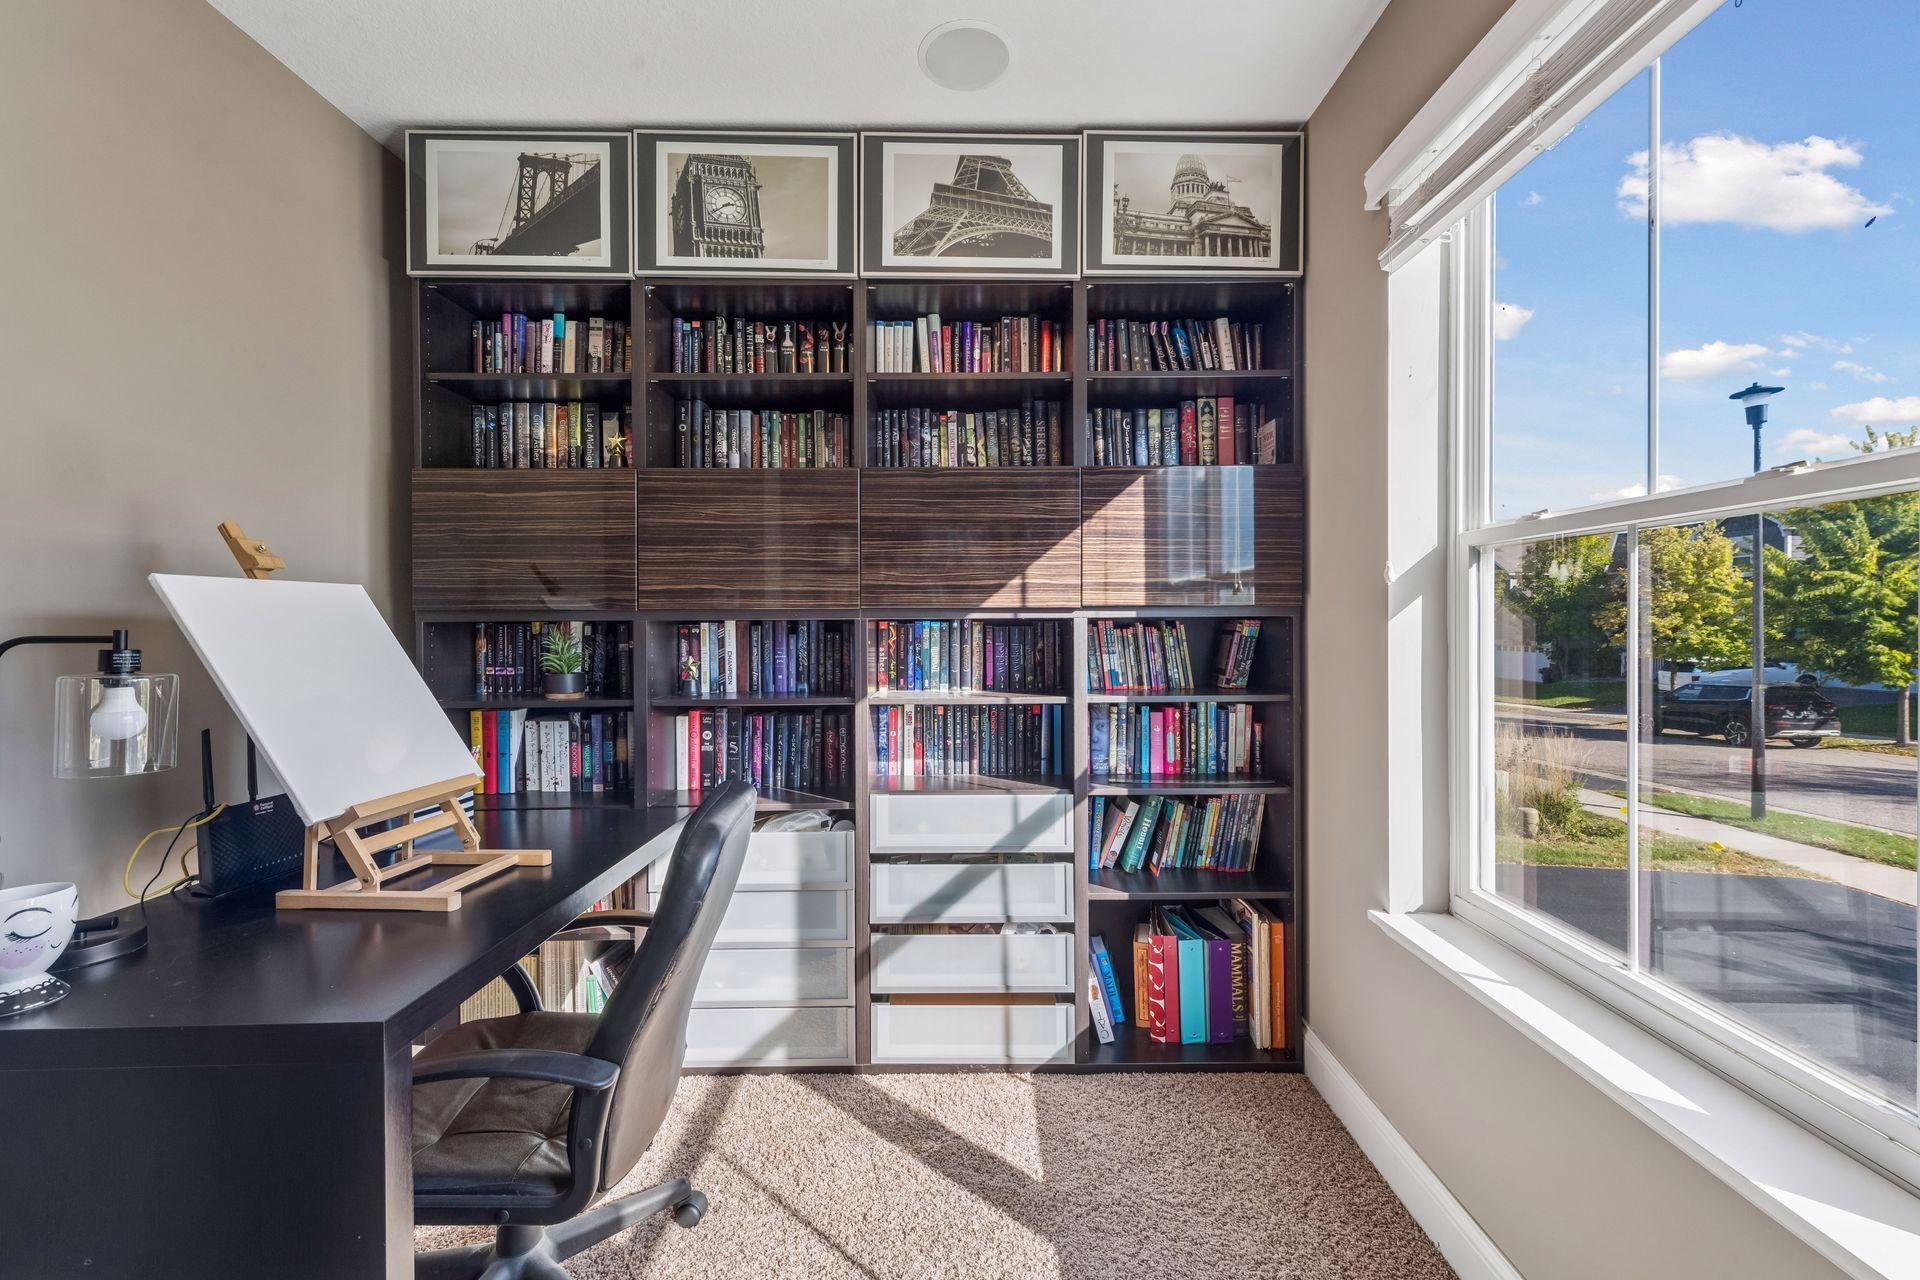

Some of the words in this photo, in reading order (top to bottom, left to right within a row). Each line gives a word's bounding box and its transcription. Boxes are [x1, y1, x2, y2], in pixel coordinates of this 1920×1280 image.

[746, 326, 754, 356] WHITE
[592, 344, 600, 373] AFTERWORLD
[746, 362, 754, 373] CA
[501, 412, 510, 426] City
[584, 414, 595, 433] Lady
[533, 440, 542, 462] Ashes
[584, 434, 595, 468] Midnight
[716, 432, 725, 459] silence
[1024, 410, 1032, 467] ANGELOLOGY
[1036, 420, 1046, 462] SEEKER
[879, 646, 888, 672] ashes
[996, 642, 1005, 674] wicked
[1010, 644, 1022, 672] wicked
[1136, 818, 1152, 851] HOBBIT
[1104, 971, 1116, 998] MATH
[1231, 943, 1243, 1012] MAMMALS
